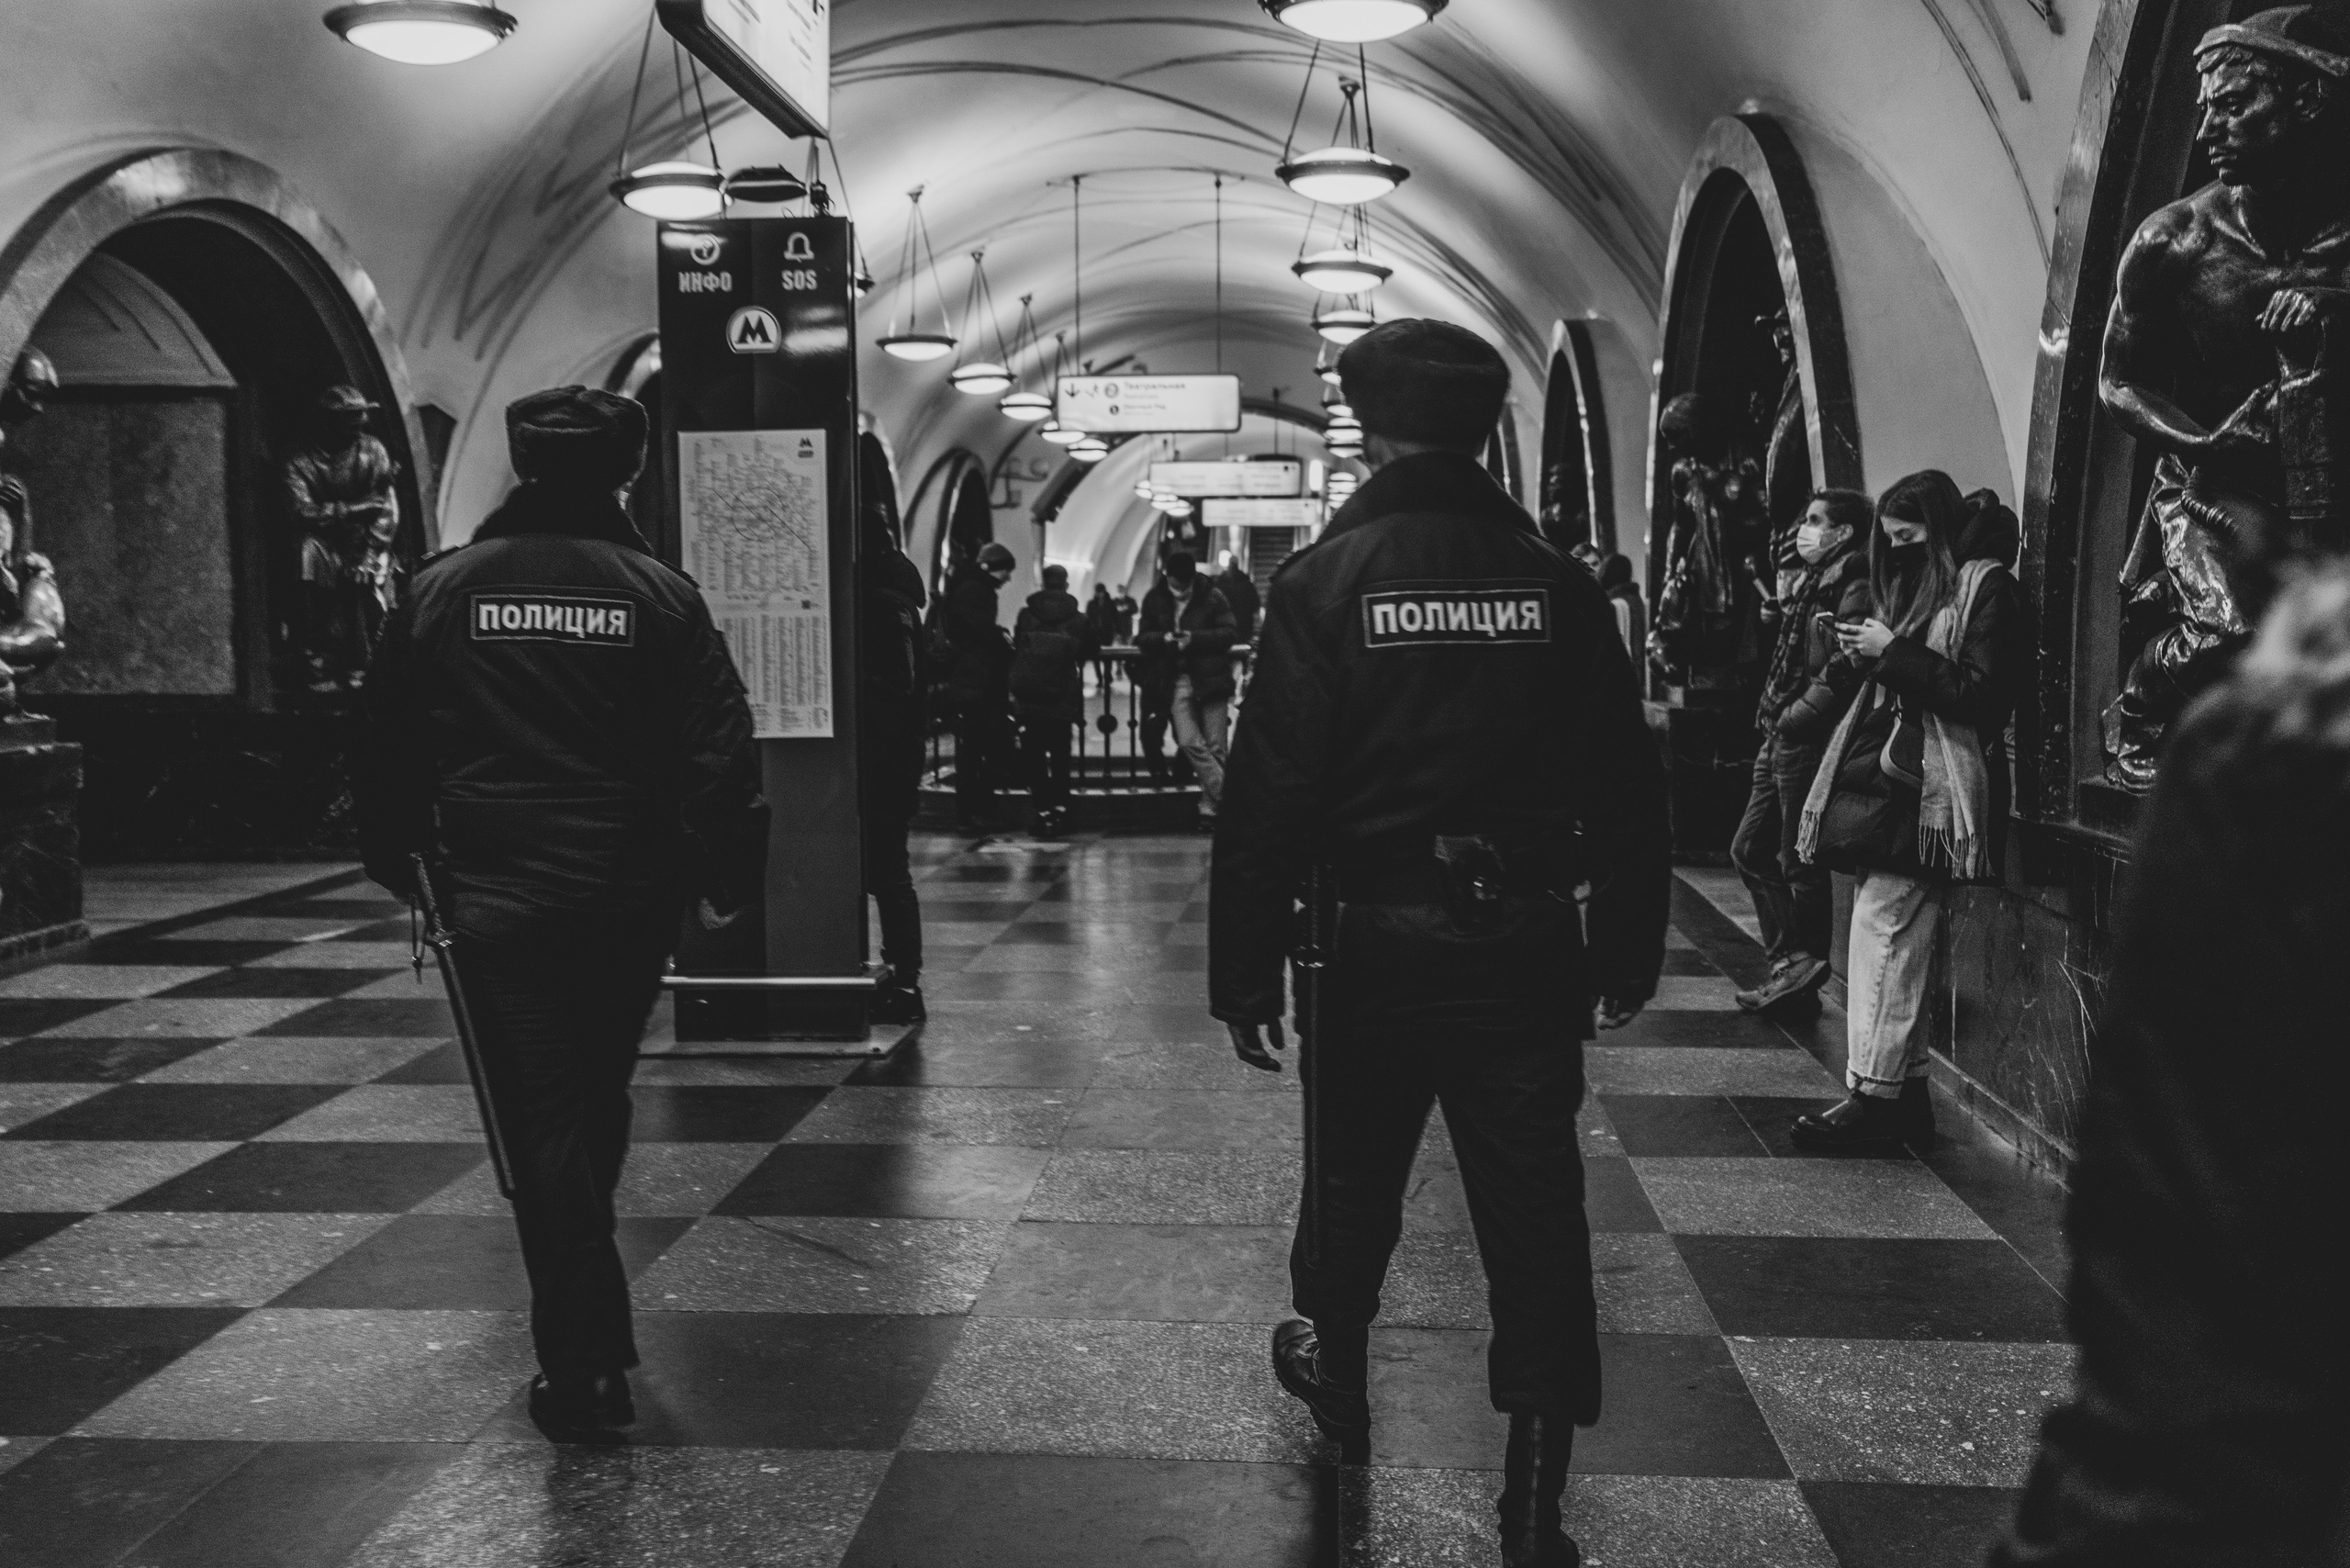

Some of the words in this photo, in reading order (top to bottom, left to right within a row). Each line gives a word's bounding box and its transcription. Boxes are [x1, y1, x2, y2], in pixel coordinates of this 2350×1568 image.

[678, 272, 733, 293] ИНФО
[781, 269, 818, 290] SOS
[479, 603, 627, 638] ПОЛИЦИЯ
[1372, 600, 1541, 637] ПОЛИЦИЯ
